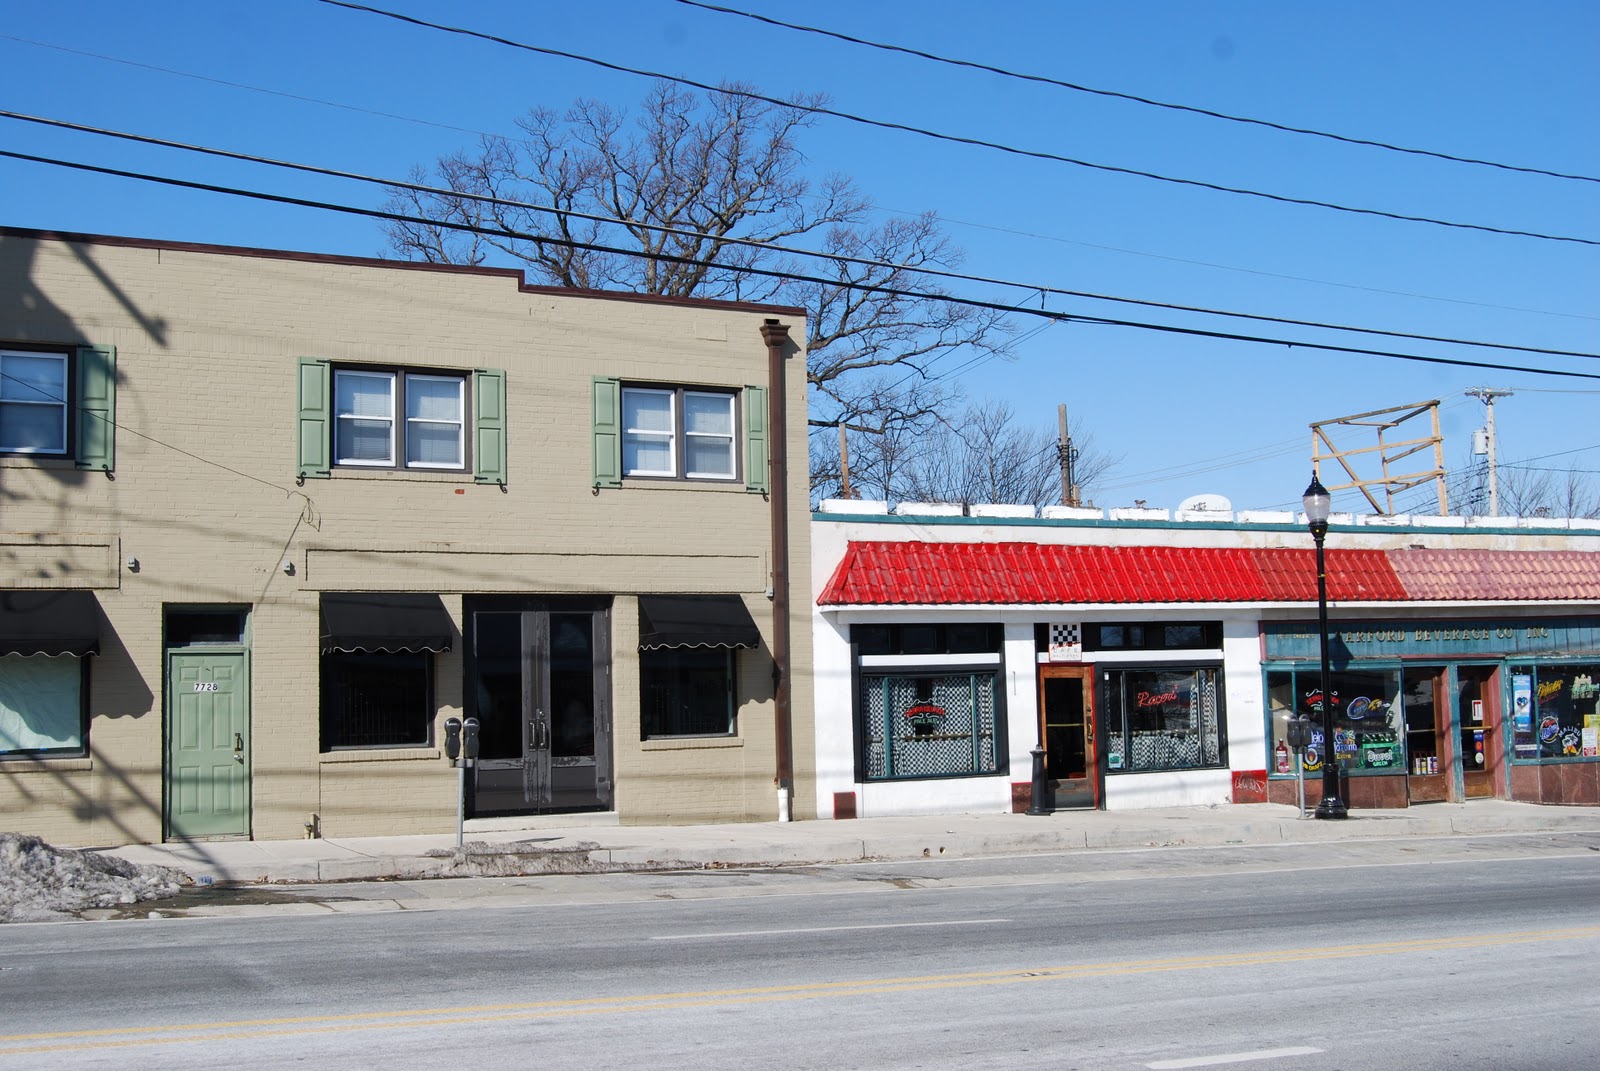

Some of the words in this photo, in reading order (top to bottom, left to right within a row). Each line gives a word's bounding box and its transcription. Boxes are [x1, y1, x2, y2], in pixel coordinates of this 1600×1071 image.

[1415, 629, 1490, 641] BEVERAGE
[1496, 627, 1514, 639] CO
[1526, 627, 1549, 639] INC
[195, 683, 218, 691] 7728
[1559, 726, 1582, 738] MALIBU
[1336, 752, 1352, 760] Extra
[1367, 749, 1393, 763] Duvel
[1309, 761, 1323, 771] DRAFT
